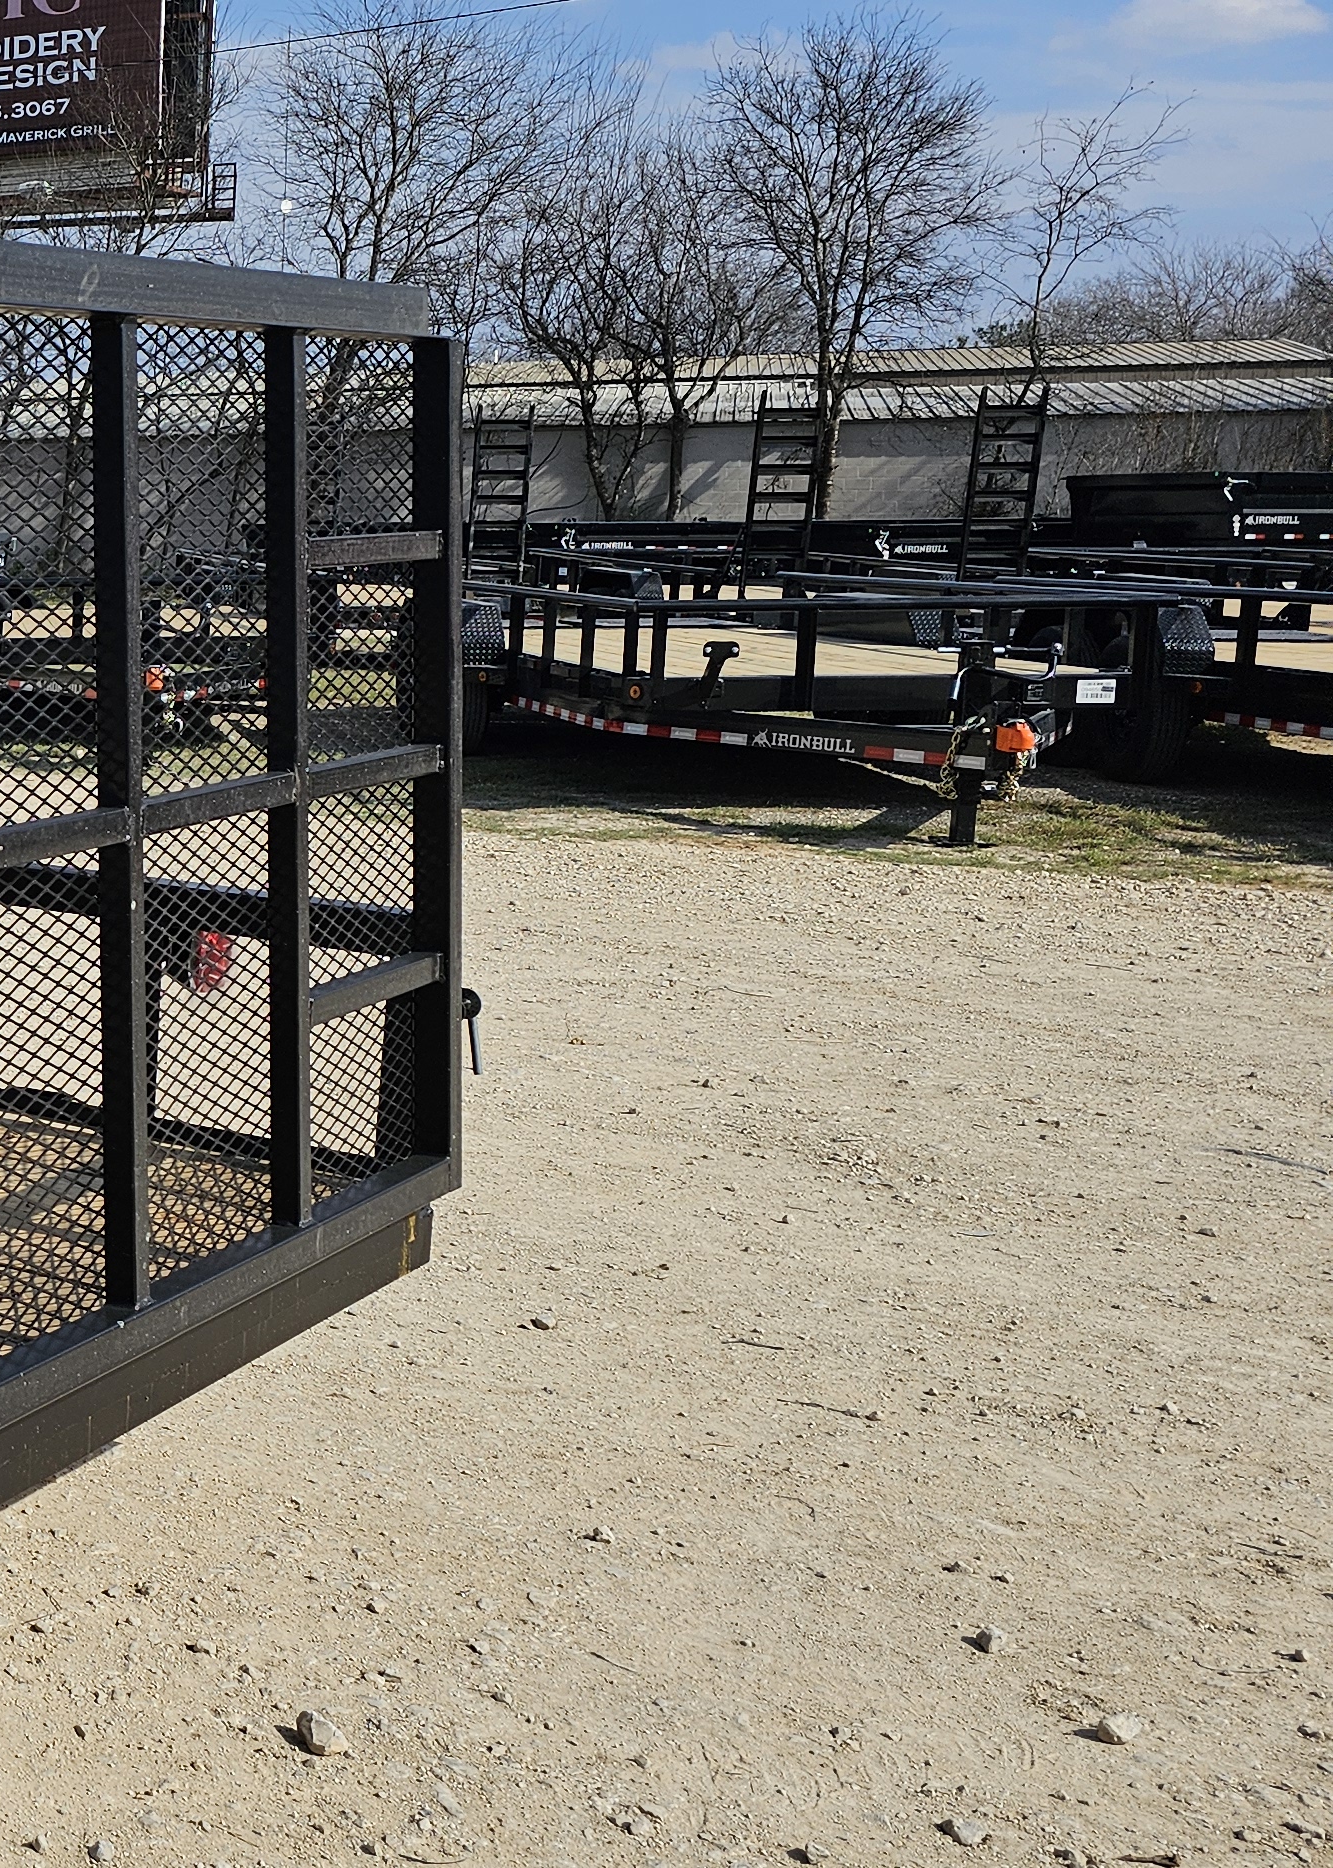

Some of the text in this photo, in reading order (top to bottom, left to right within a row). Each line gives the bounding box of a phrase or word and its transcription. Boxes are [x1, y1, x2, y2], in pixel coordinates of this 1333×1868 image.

[1255, 515, 1301, 525] IRONBULL
[904, 543, 949, 554] IRONBULL
[770, 731, 856, 755] IRONBULL
